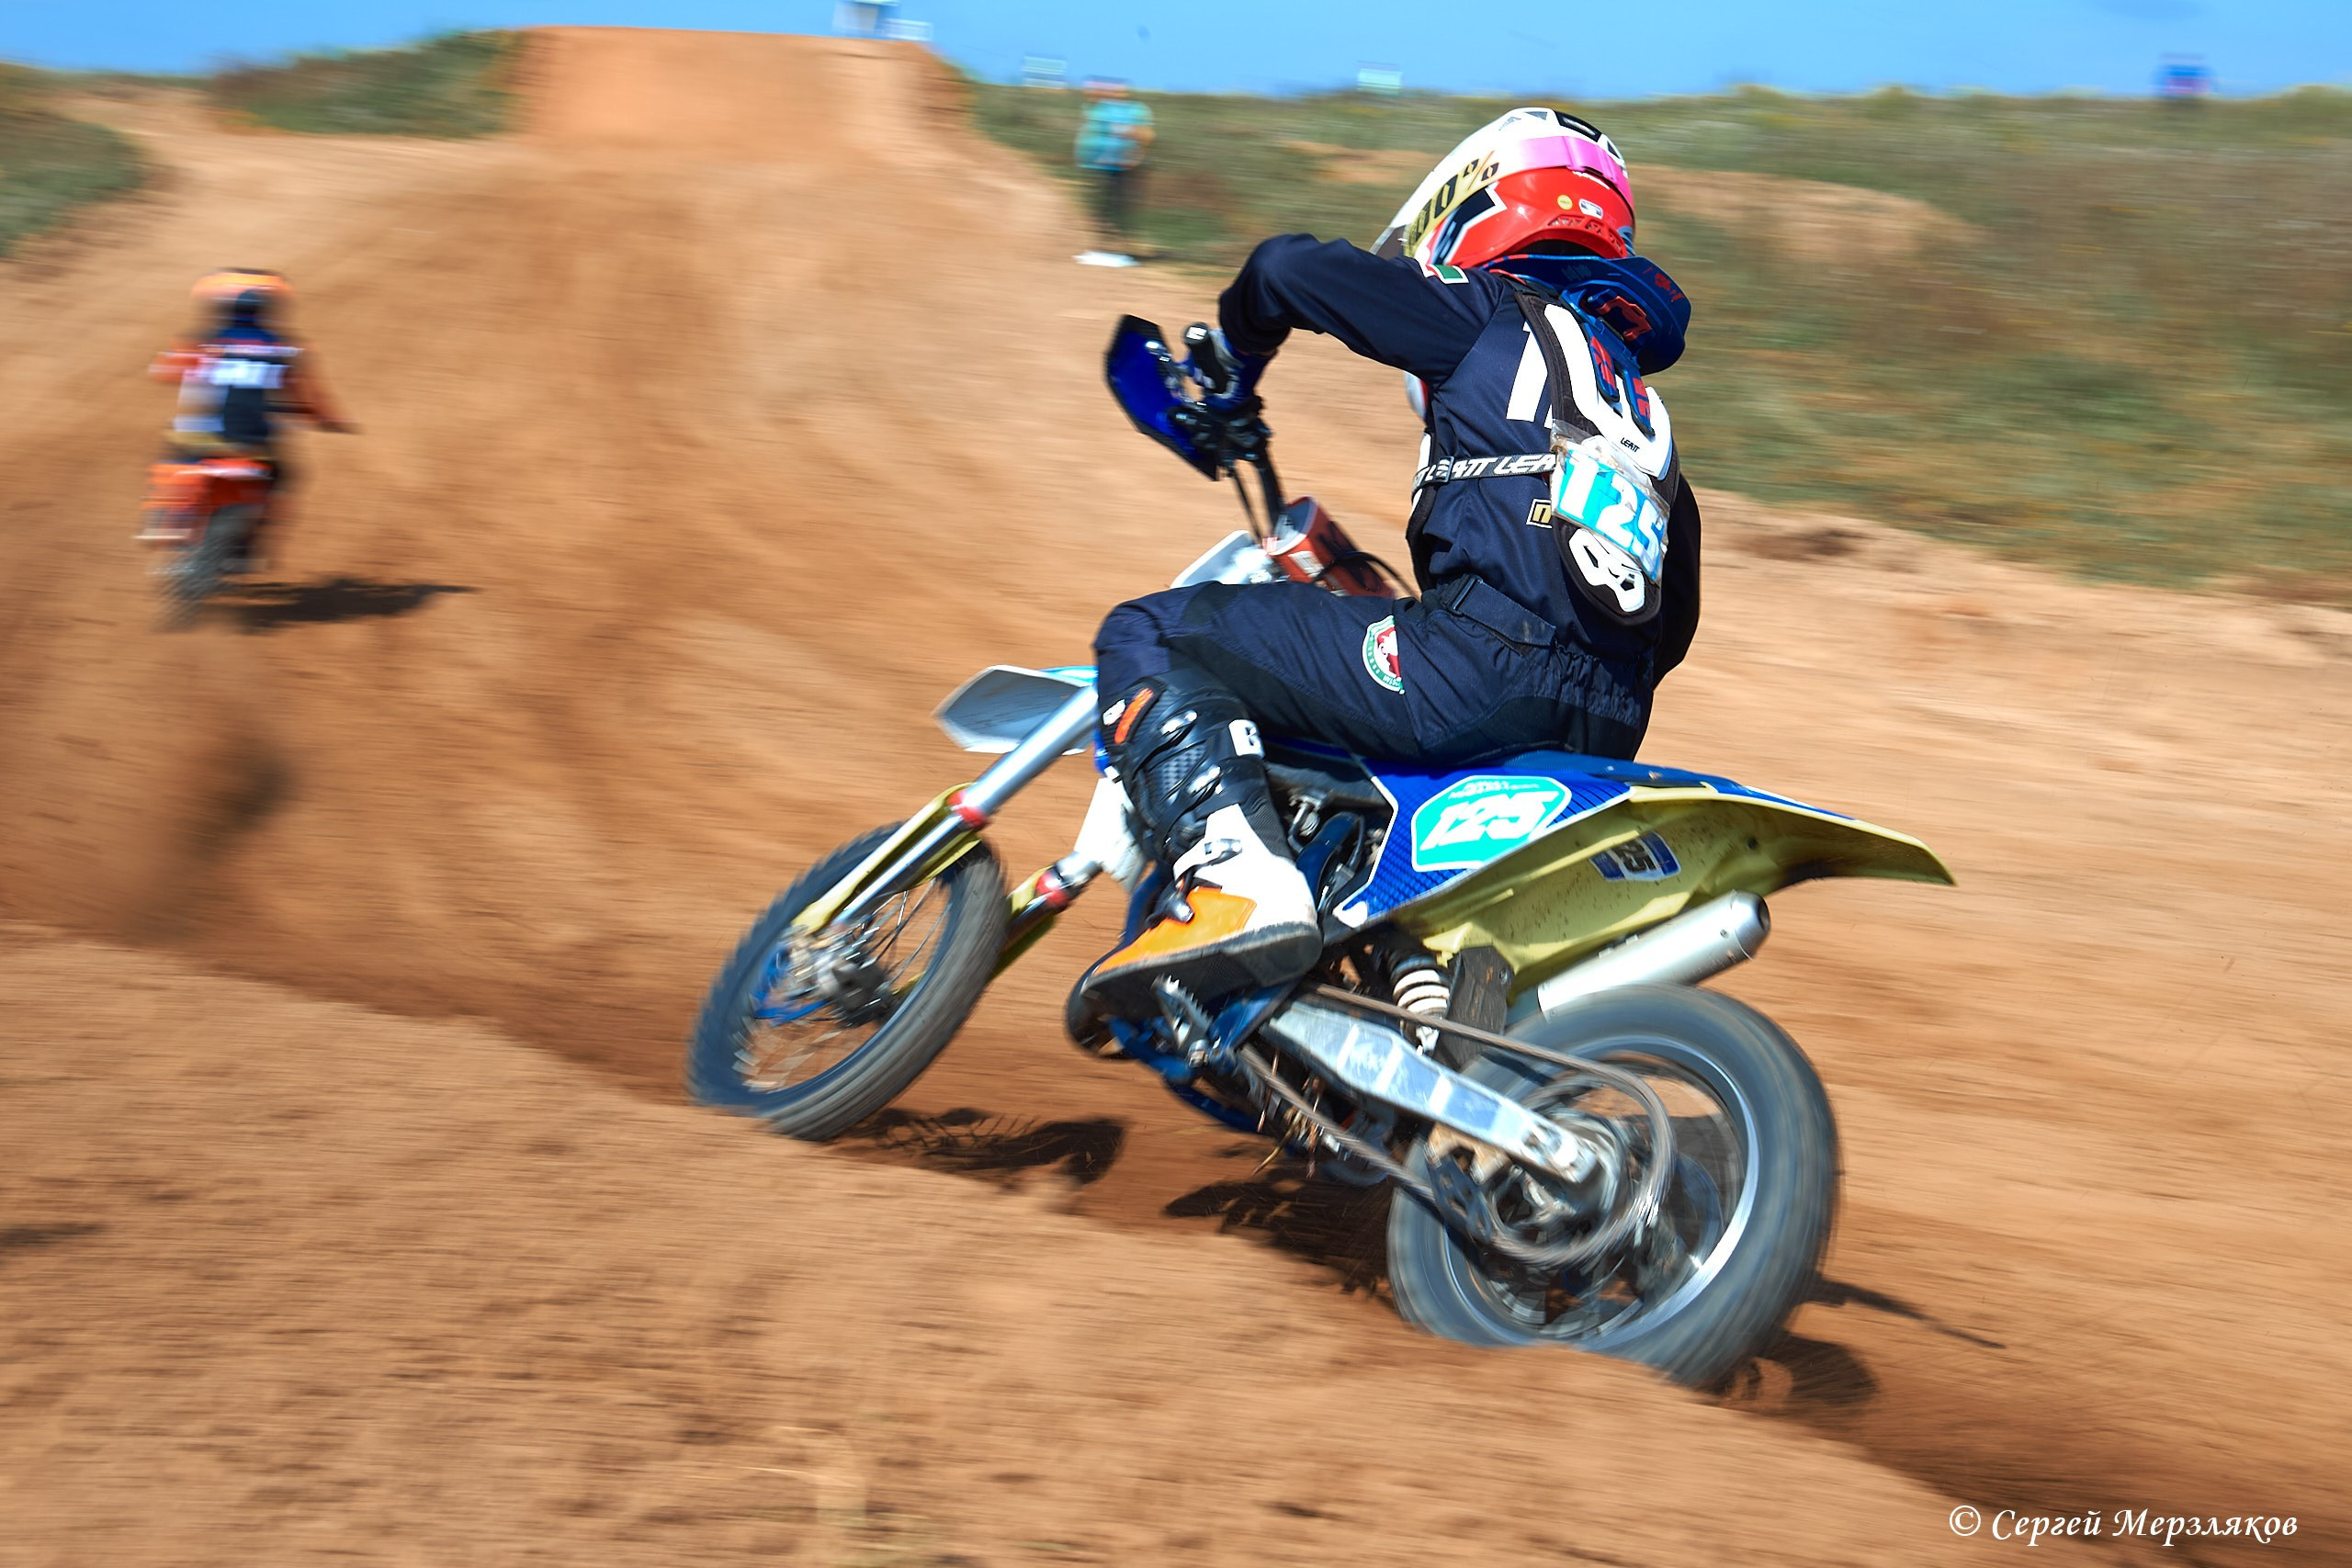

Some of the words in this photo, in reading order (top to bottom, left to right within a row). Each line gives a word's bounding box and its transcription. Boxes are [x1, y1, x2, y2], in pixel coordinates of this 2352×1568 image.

[1620, 437, 1640, 452] LEATT
[1559, 451, 1664, 573] 125
[1420, 791, 1560, 850] 125
